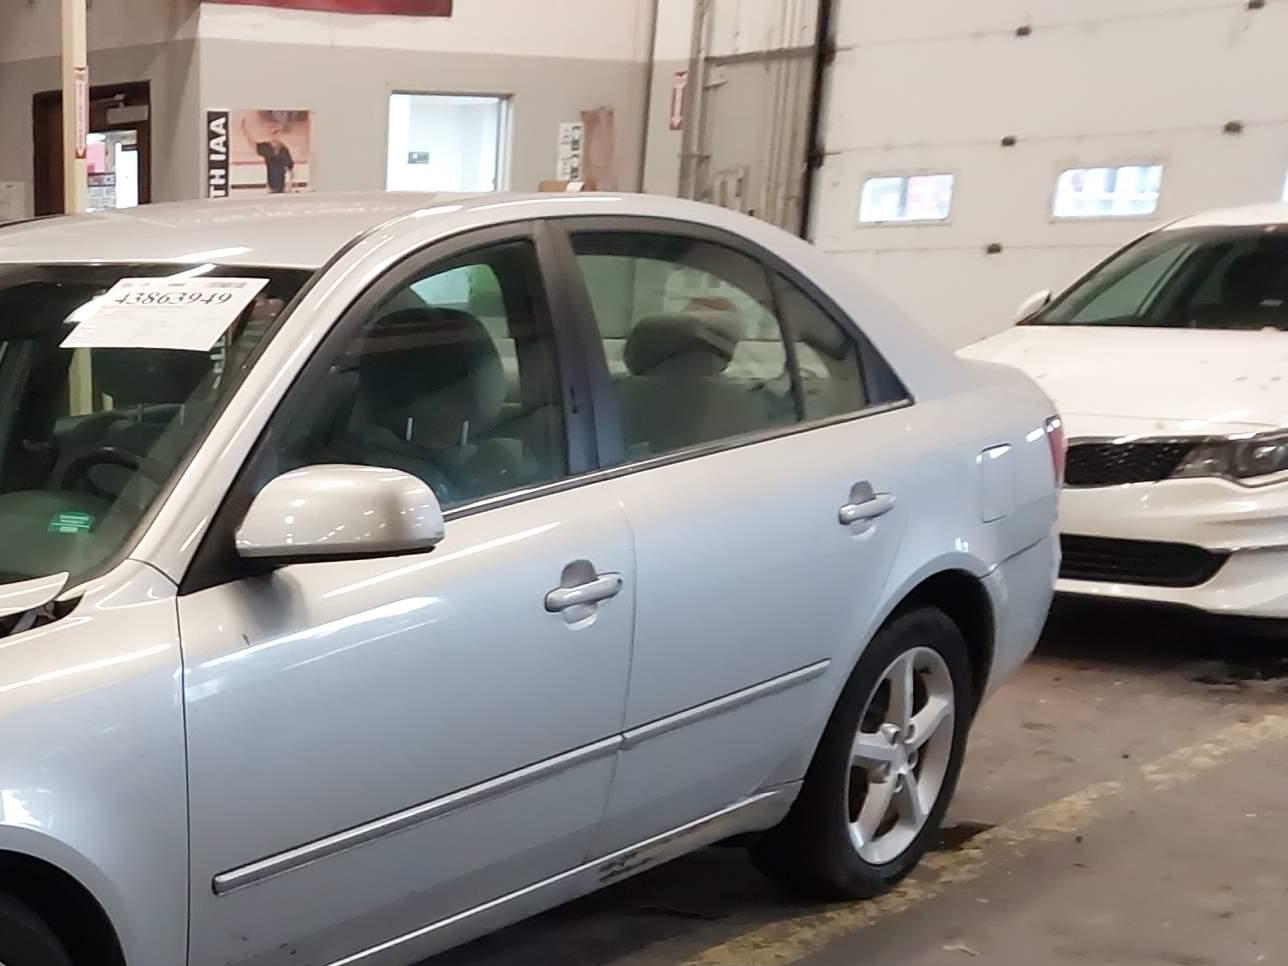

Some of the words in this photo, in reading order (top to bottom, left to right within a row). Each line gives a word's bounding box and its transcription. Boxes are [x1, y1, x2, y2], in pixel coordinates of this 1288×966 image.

[209, 116, 227, 161] IAA
[209, 168, 227, 198] TH
[114, 292, 233, 305] 43863949
